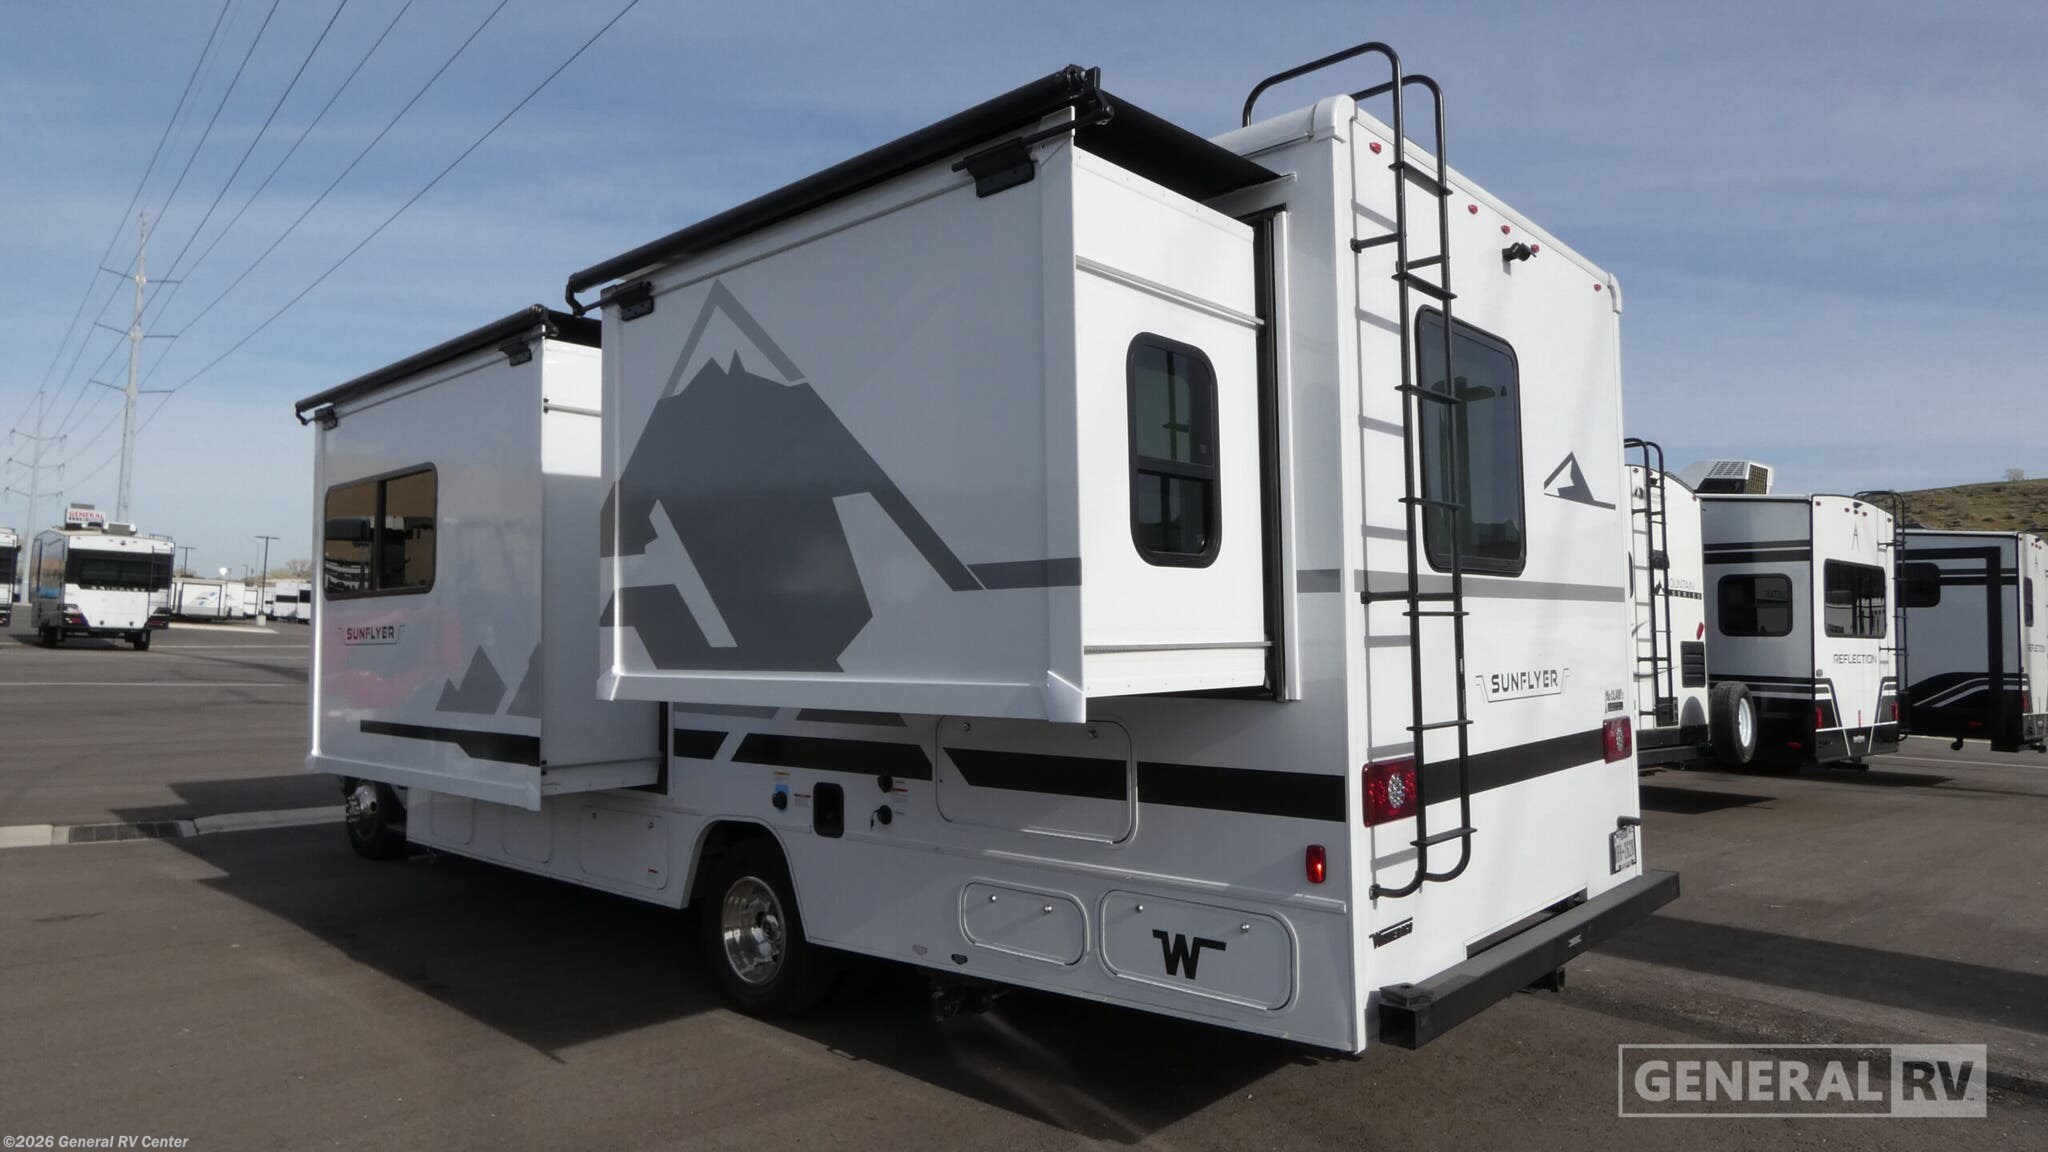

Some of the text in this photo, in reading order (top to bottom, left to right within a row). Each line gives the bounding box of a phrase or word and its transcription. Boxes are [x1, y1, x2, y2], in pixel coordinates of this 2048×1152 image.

[69, 511, 104, 519] GENERAL
[347, 626, 395, 640] SUNFLYER
[1833, 653, 1877, 664] REFLECTION
[1491, 669, 1558, 693] SUNFLYER
